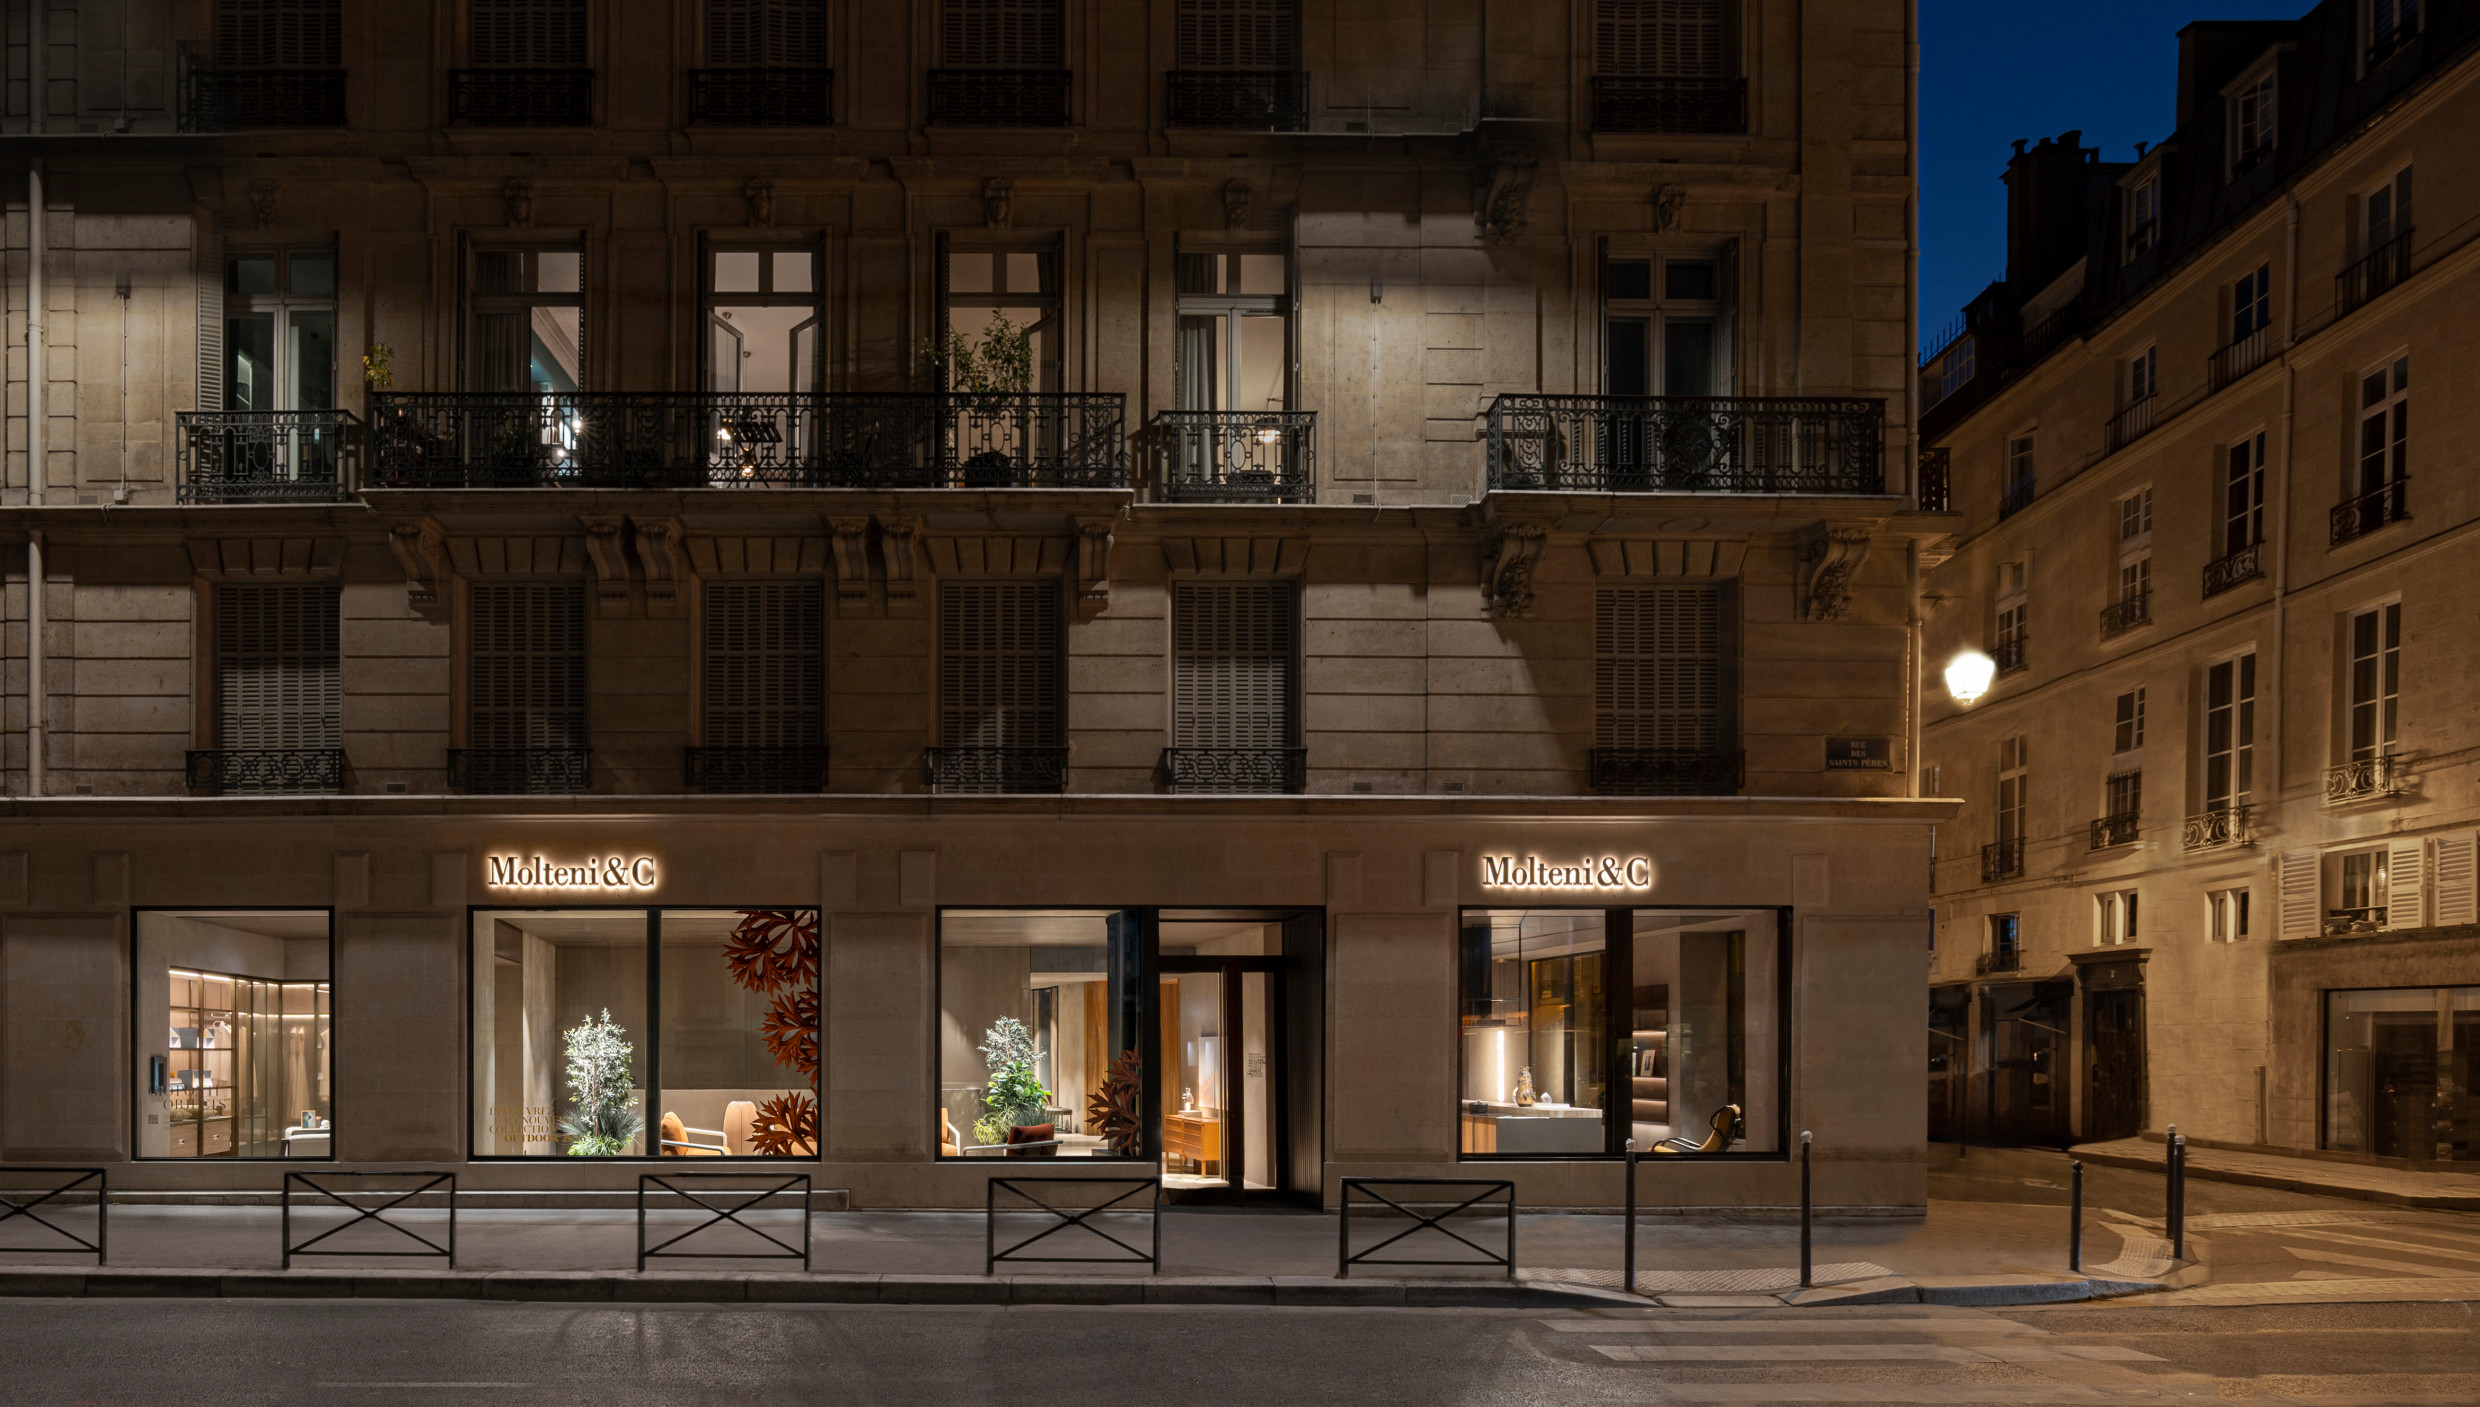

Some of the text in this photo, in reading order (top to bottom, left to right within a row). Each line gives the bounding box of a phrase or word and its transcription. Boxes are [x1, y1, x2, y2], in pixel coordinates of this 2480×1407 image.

[1850, 741, 1866, 749] RUE
[1829, 759, 1859, 767] SAINTS
[487, 856, 655, 887] Molteni&C
[1482, 856, 1649, 887] Molteni&C
[504, 1134, 559, 1143] OUTDOOR
